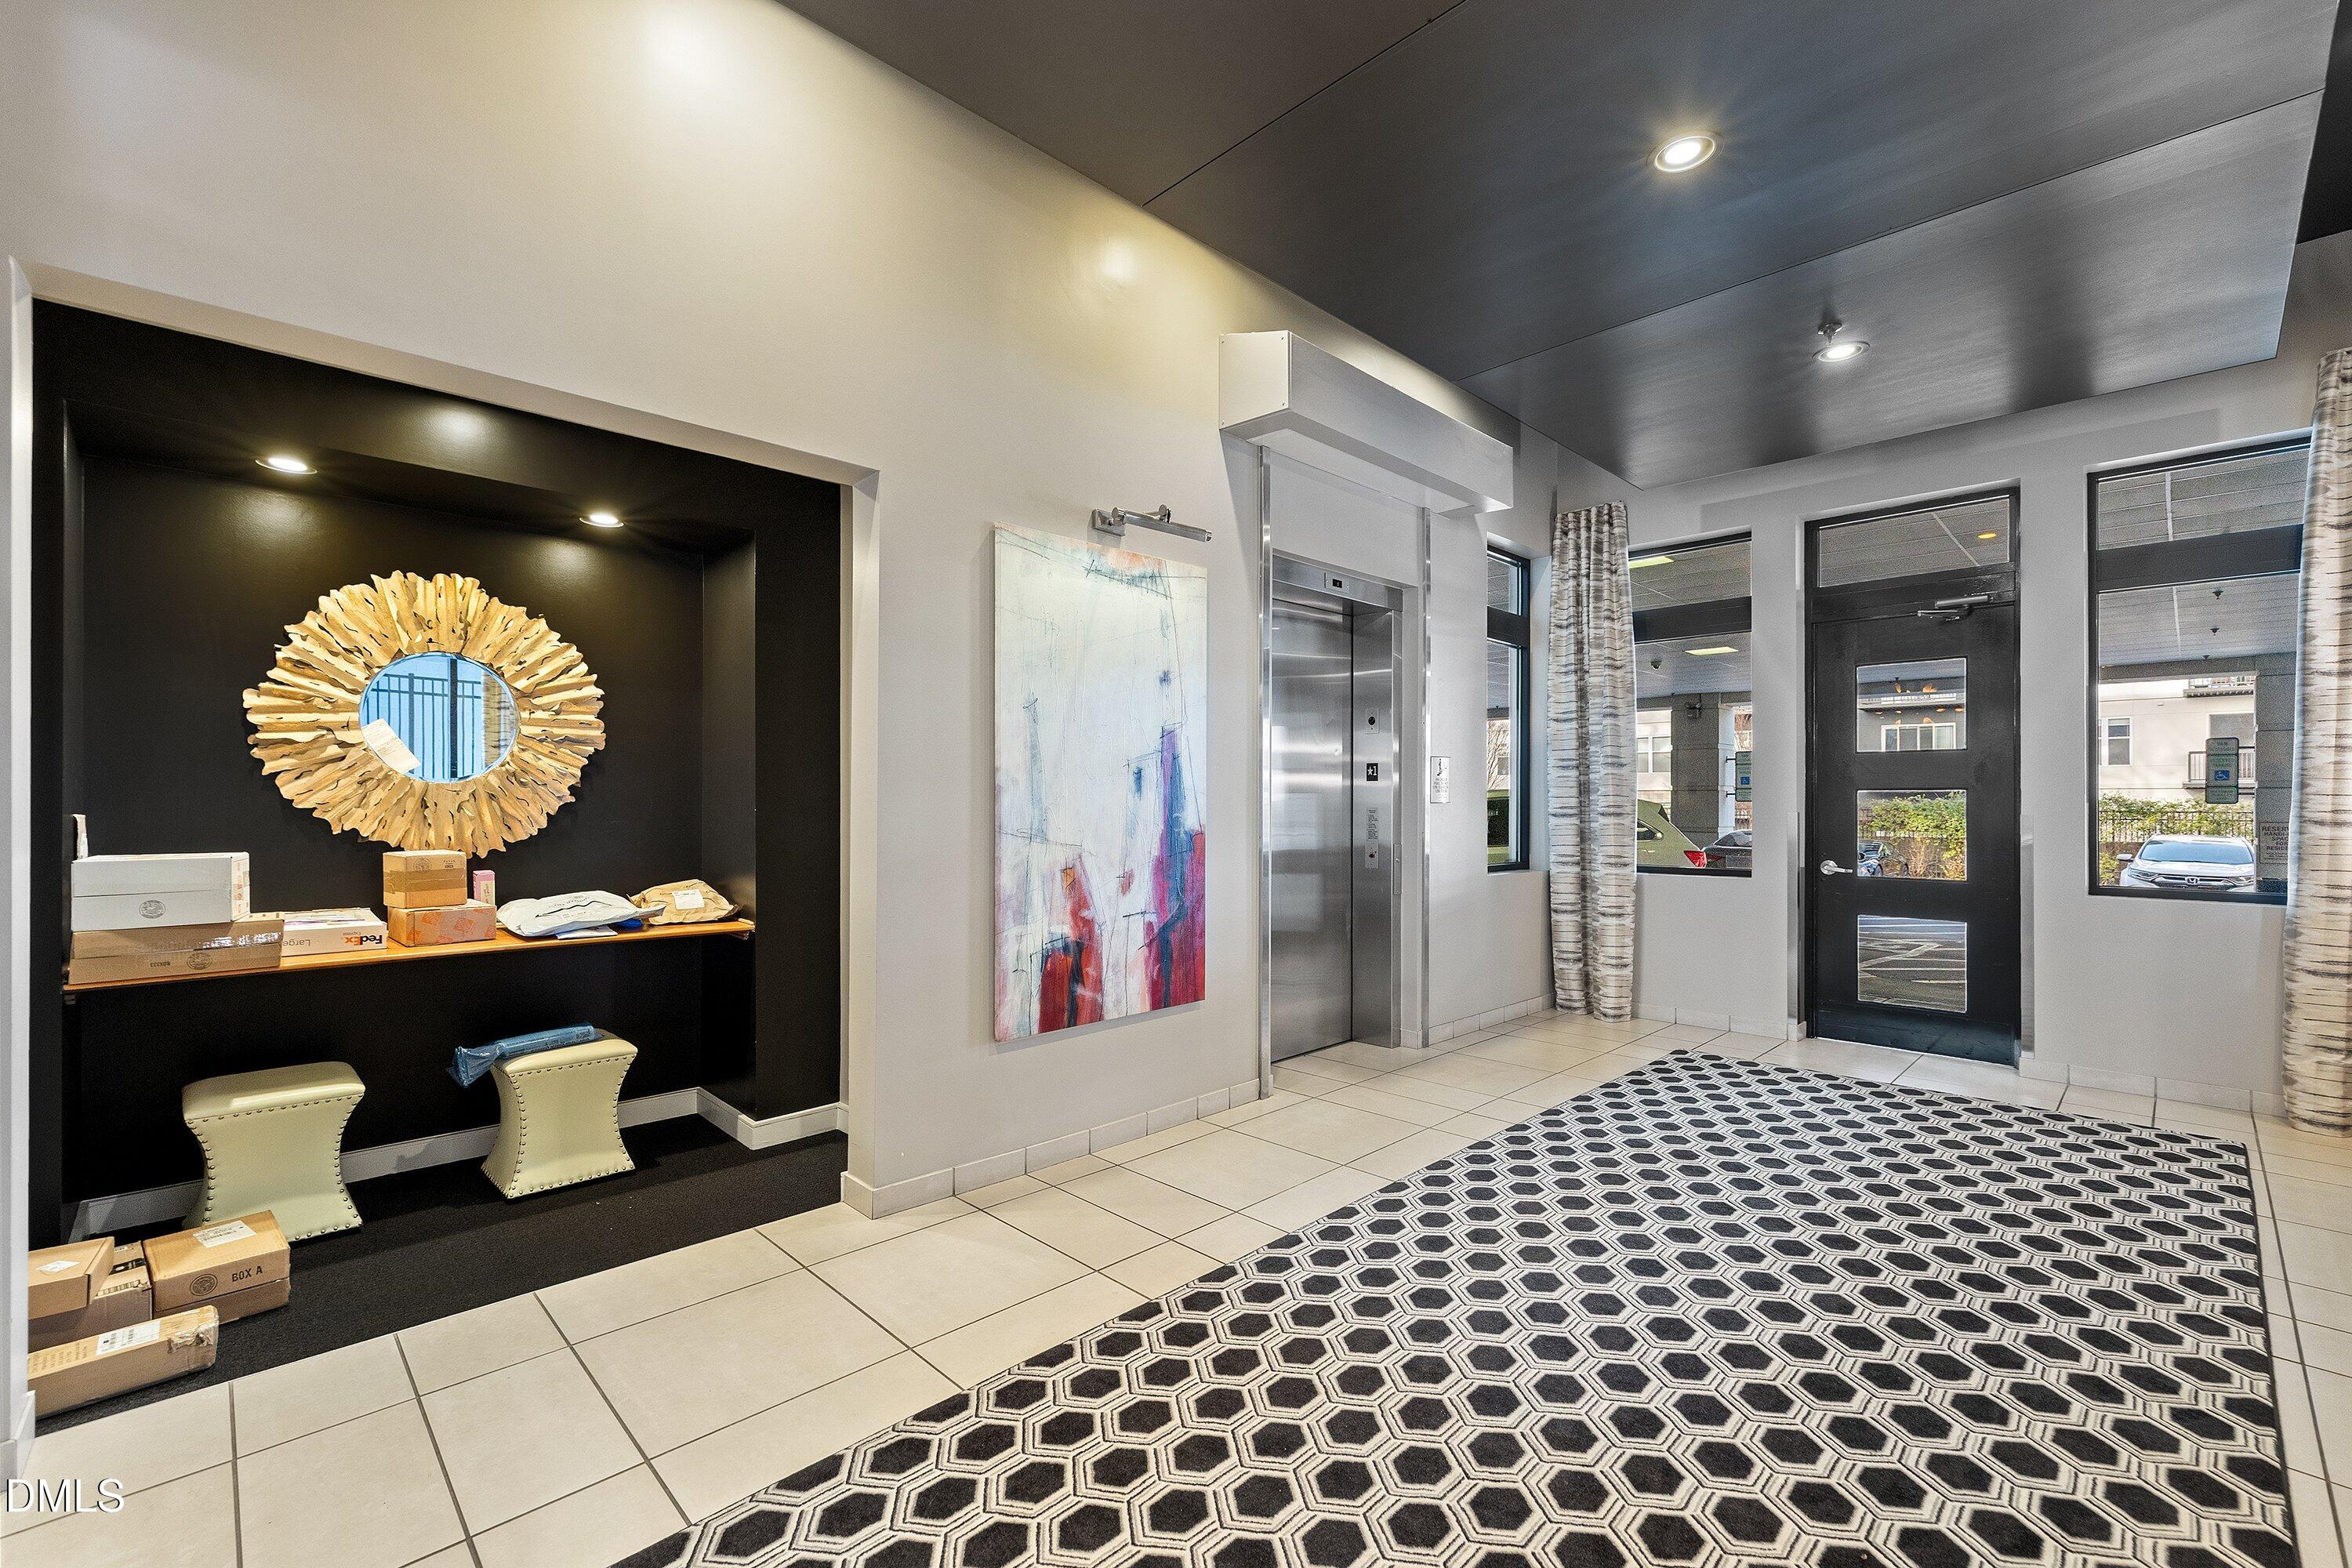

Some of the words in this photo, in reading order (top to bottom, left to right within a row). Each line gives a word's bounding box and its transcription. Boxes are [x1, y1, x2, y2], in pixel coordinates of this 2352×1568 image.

[344, 935, 383, 946] FedEx
[231, 1268, 252, 1283] BOX
[256, 1265, 263, 1276] A
